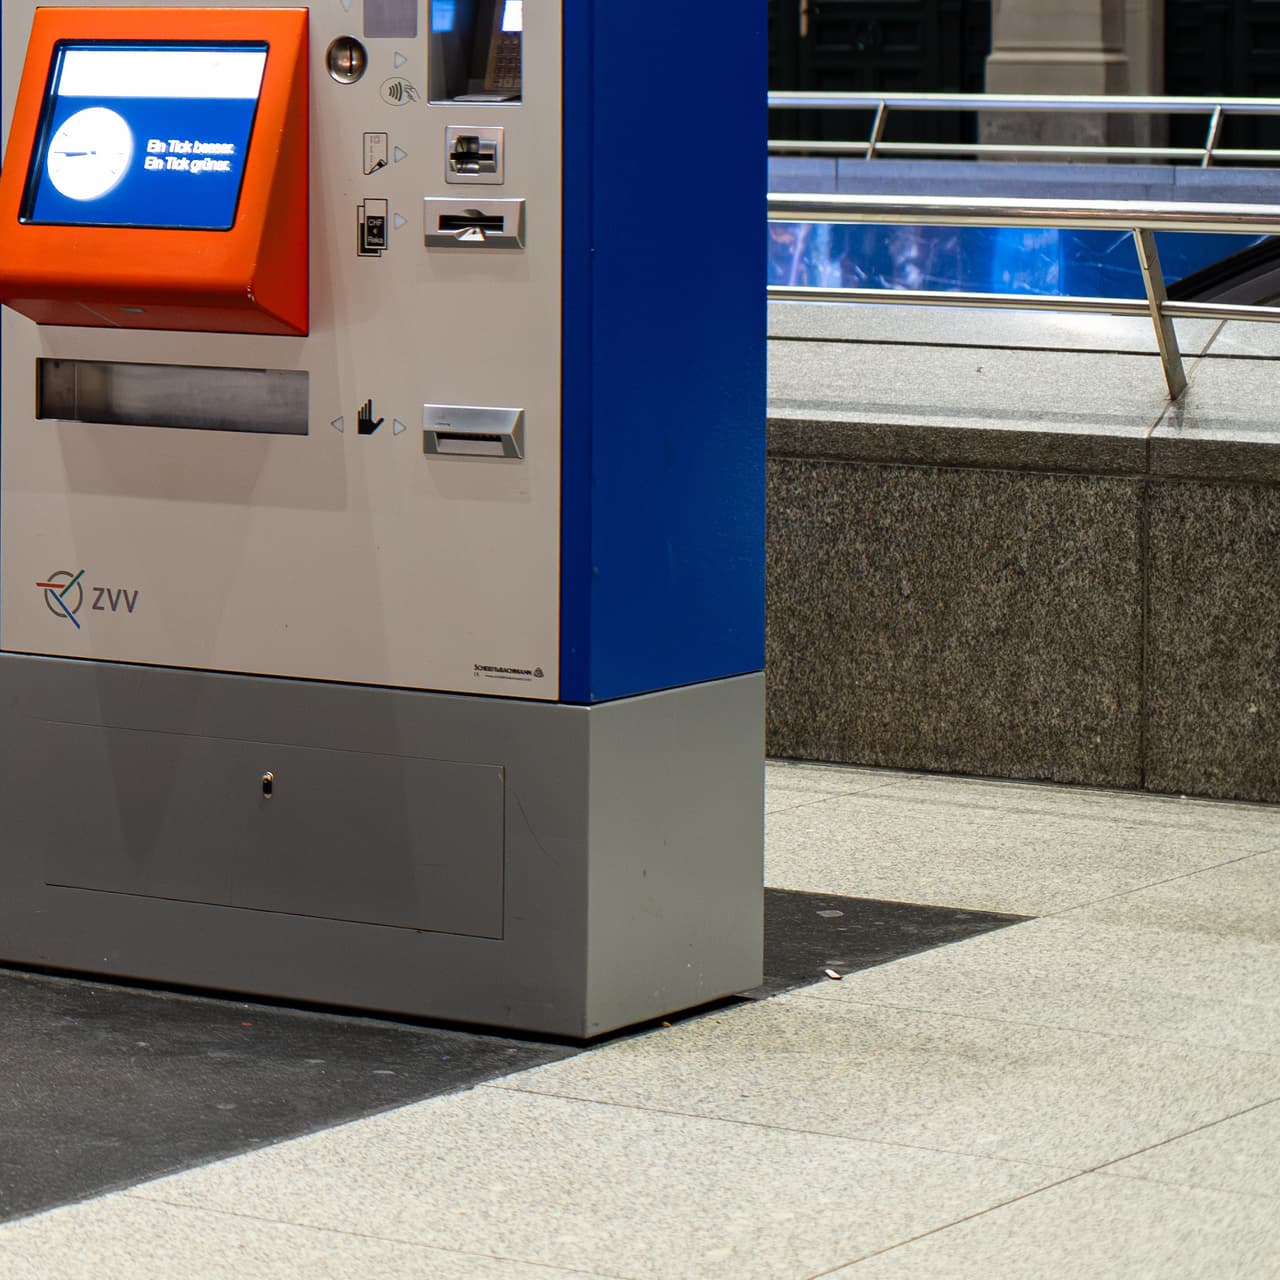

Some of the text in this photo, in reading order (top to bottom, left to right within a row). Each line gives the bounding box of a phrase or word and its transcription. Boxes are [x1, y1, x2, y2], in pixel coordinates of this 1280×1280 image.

[168, 139, 192, 153] Tick
[165, 156, 190, 170] Tick
[92, 587, 139, 613] ZVV
